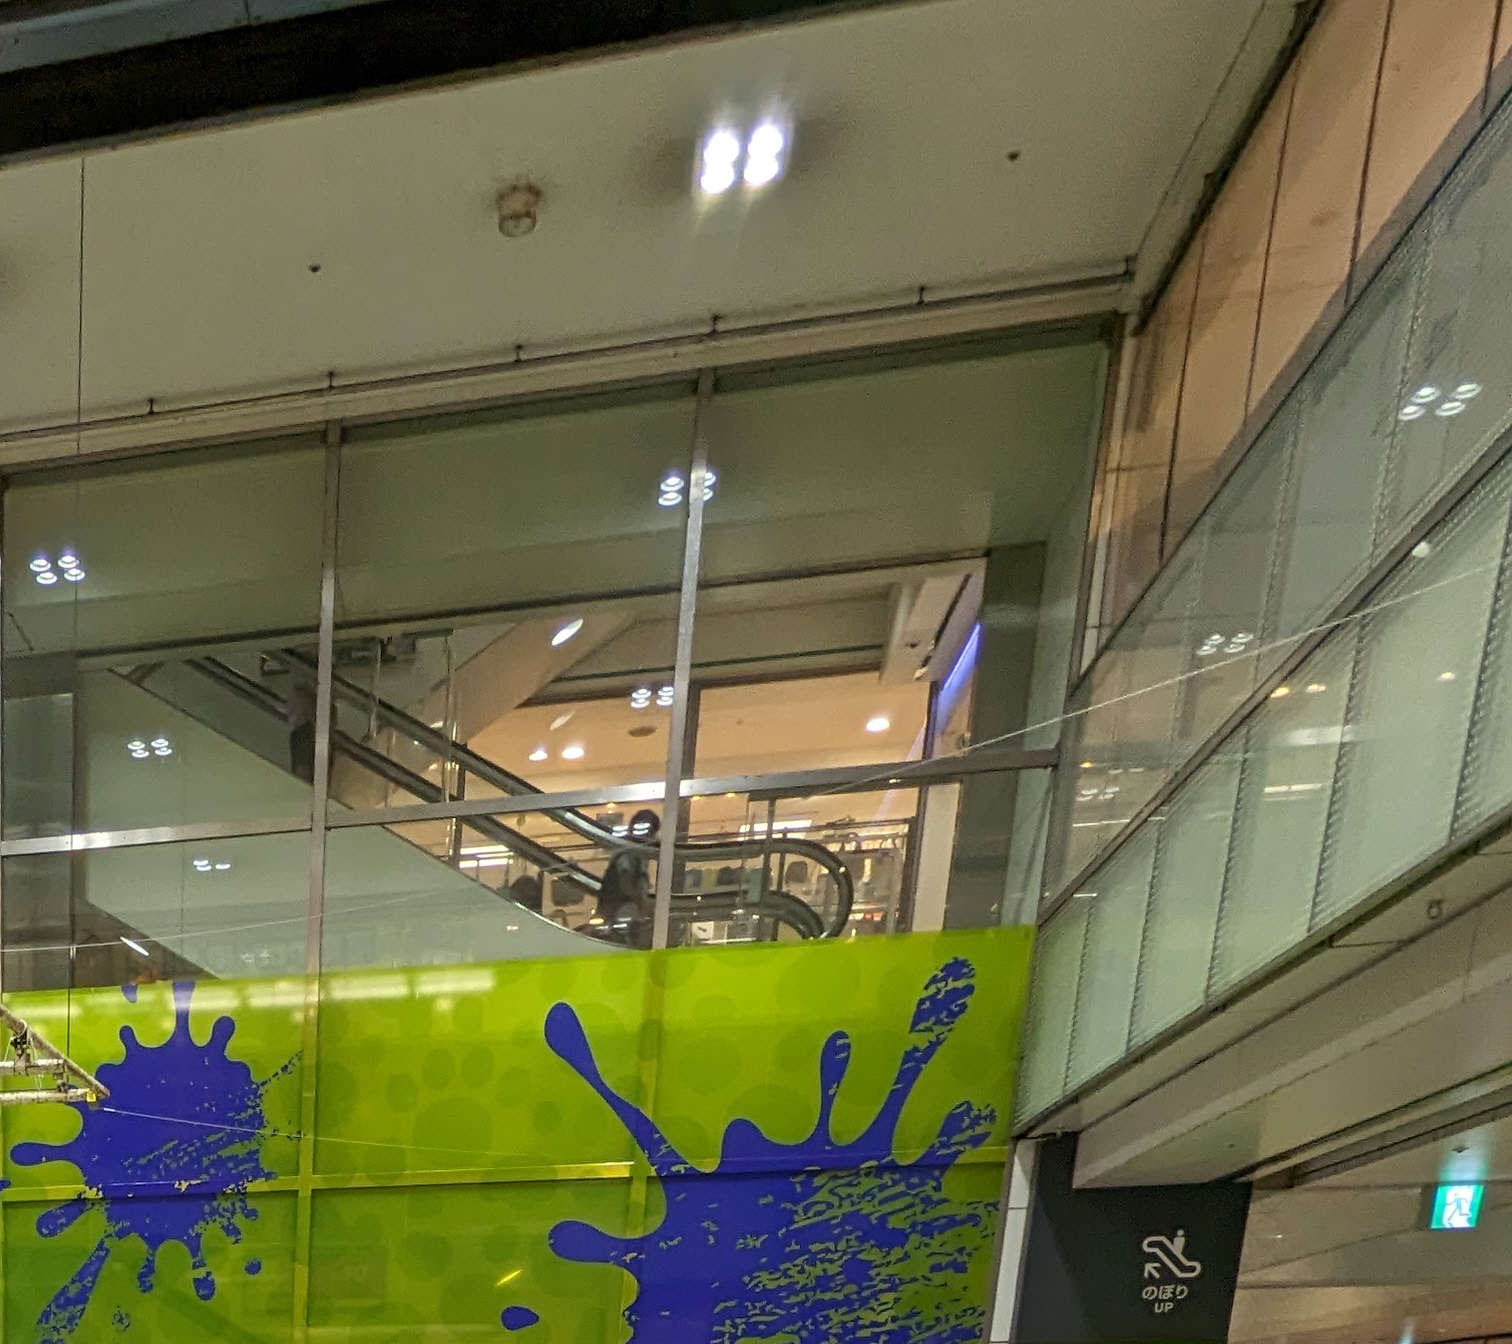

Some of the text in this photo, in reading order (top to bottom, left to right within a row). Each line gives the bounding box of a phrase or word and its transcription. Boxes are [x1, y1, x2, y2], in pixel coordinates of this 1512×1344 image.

[1142, 1285, 1189, 1300] のぼり
[1154, 1302, 1174, 1313] UP
